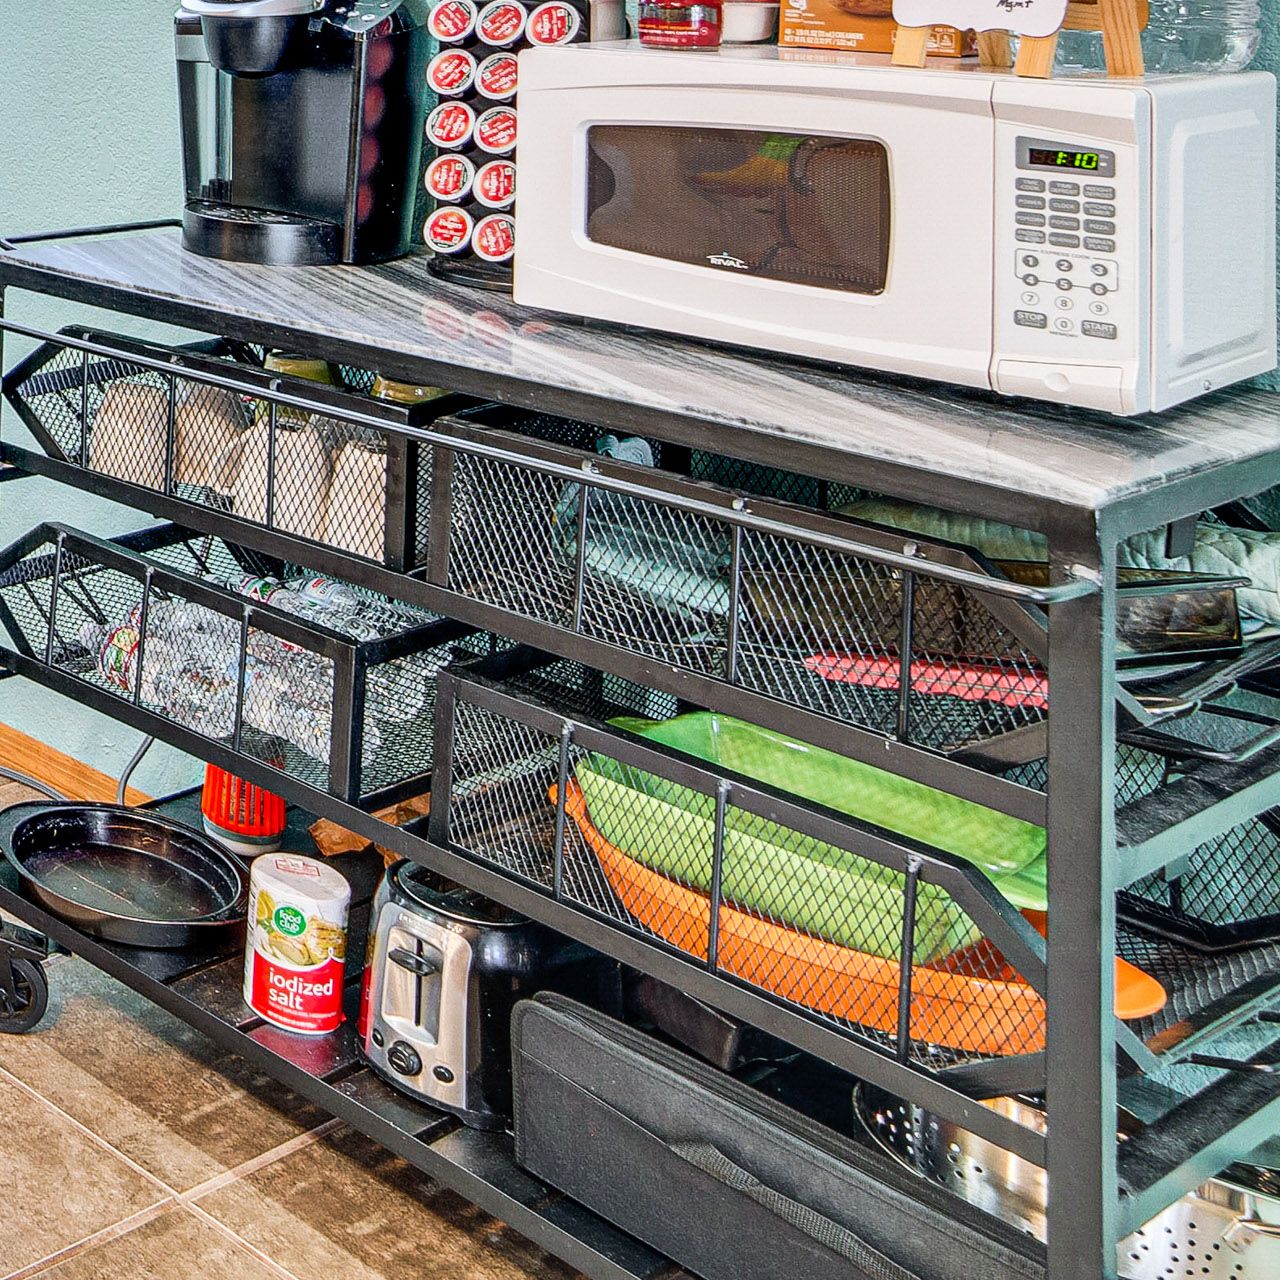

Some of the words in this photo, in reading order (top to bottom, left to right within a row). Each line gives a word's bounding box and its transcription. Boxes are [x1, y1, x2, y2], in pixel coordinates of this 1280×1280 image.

[710, 257, 745, 269] RIVAL
[1016, 312, 1045, 321] STOP
[1060, 320, 1068, 329] 0
[1082, 321, 1115, 332] START
[279, 908, 302, 926] food
[279, 918, 301, 933] club
[268, 967, 334, 997] iodized
[268, 987, 304, 1011] salt
